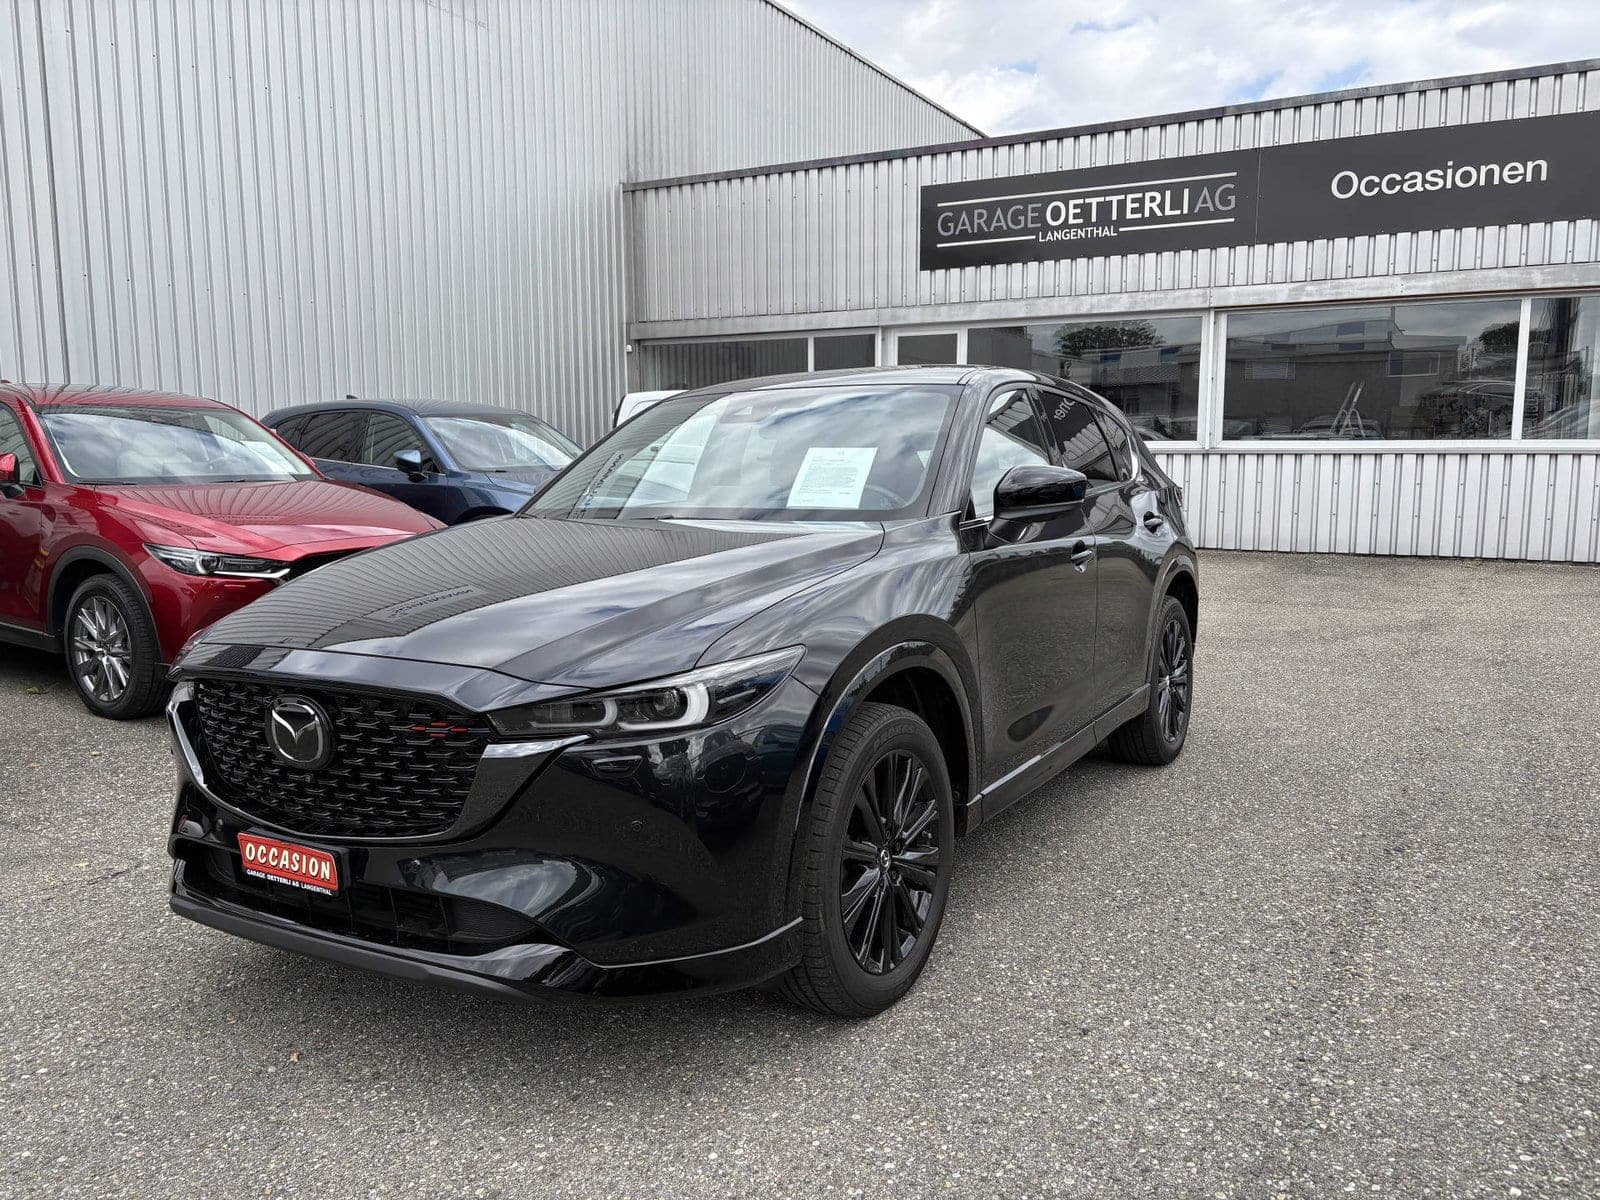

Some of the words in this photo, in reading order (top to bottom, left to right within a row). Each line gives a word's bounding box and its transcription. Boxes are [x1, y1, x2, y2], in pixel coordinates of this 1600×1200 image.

[1331, 159, 1549, 199] Occasionen
[937, 203, 1042, 236] GARAGE
[1045, 188, 1190, 227] OETTERLI
[1193, 183, 1237, 214] AG
[1038, 225, 1118, 243] LANGENTHAL
[245, 842, 331, 880] OCCASION
[246, 869, 266, 879] GARAGE
[291, 880, 300, 888] AG
[300, 882, 333, 896] LANGENTHAL
